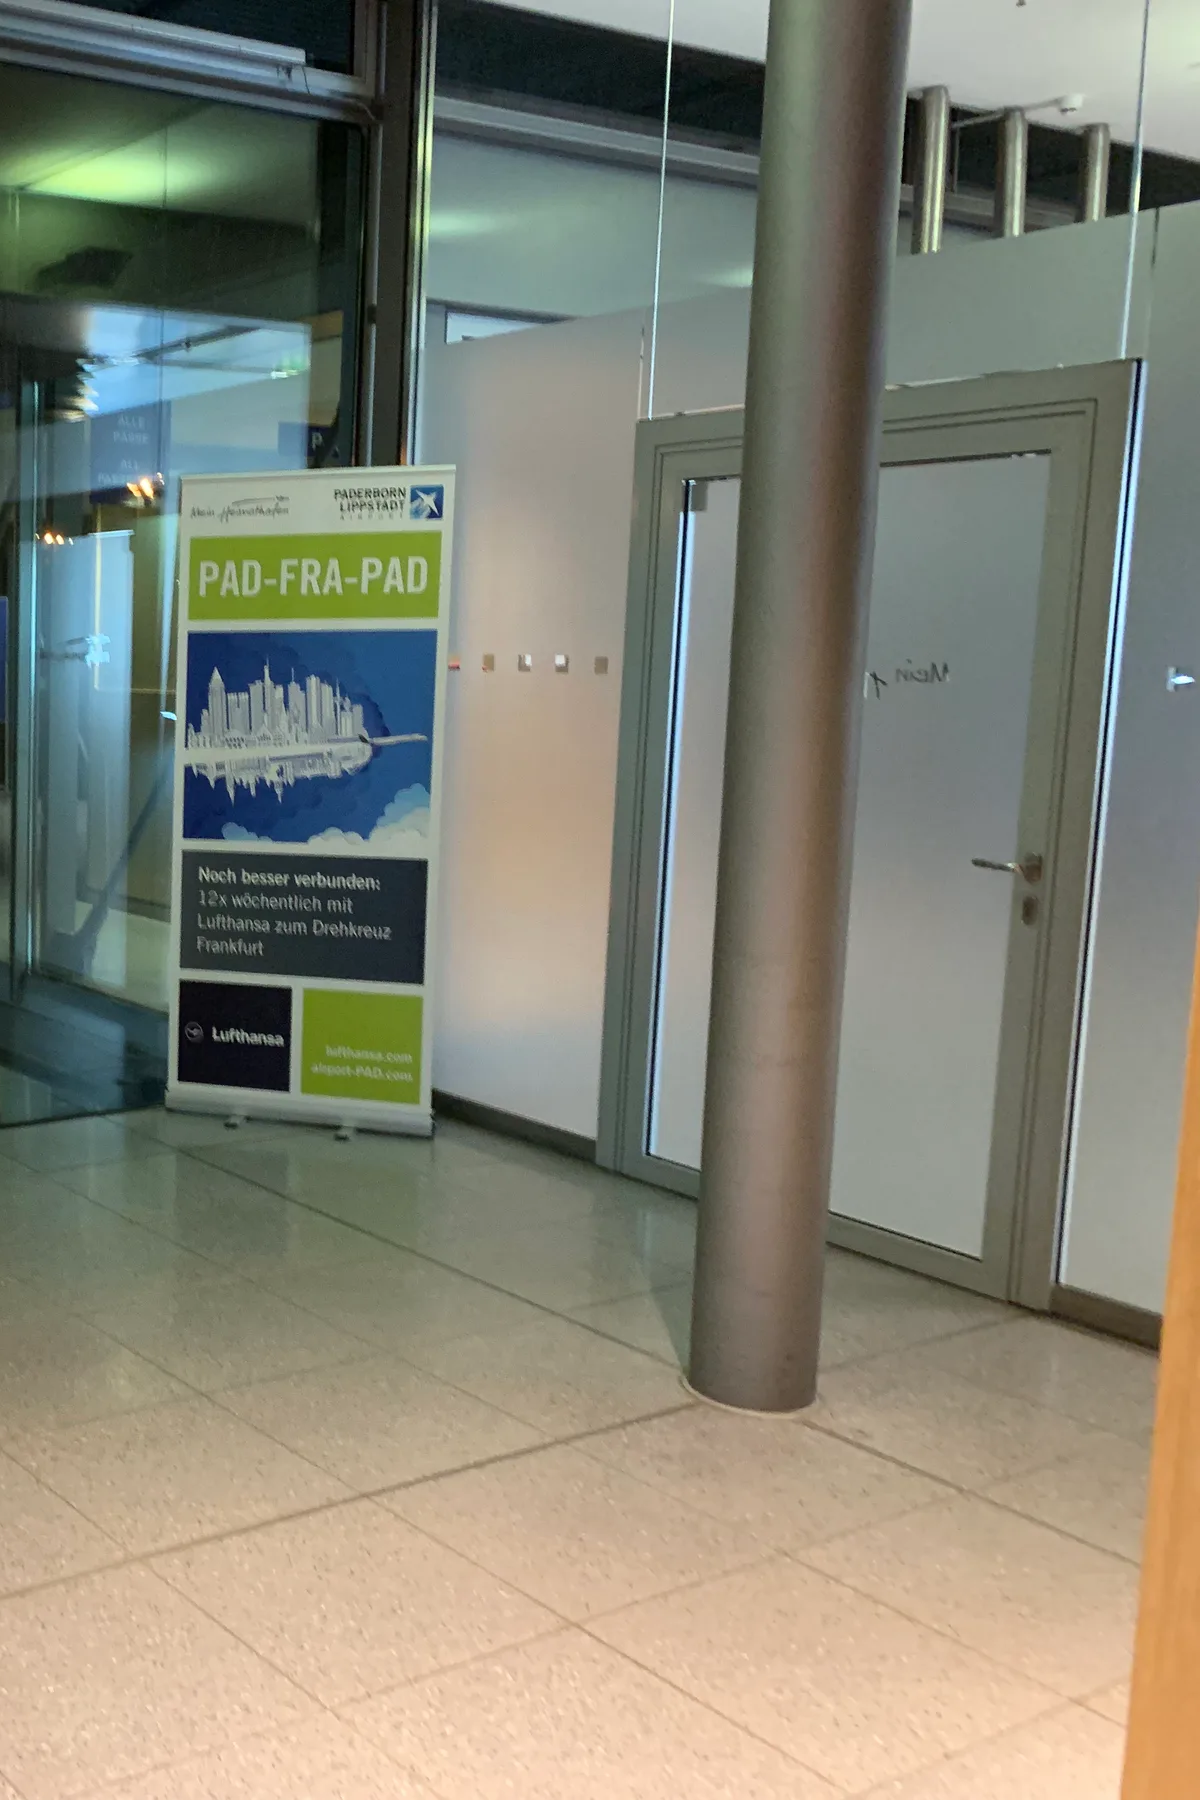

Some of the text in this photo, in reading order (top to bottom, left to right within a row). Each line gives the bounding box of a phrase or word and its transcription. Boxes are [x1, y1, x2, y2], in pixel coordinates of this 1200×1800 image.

[334, 487, 406, 501] PADERBORN
[340, 499, 405, 513] LIPPSTADT
[199, 556, 428, 597] PAD-FRA-PAD
[198, 866, 381, 891] Noch besser verbunden:
[199, 889, 353, 914] 12x wöchentlich mit
[197, 912, 392, 940] Lufthansa zum Drehkreuz
[196, 935, 264, 956] Frankfurt
[211, 1026, 285, 1047] Lufthansa
[325, 1045, 413, 1064] lufthansa.com
